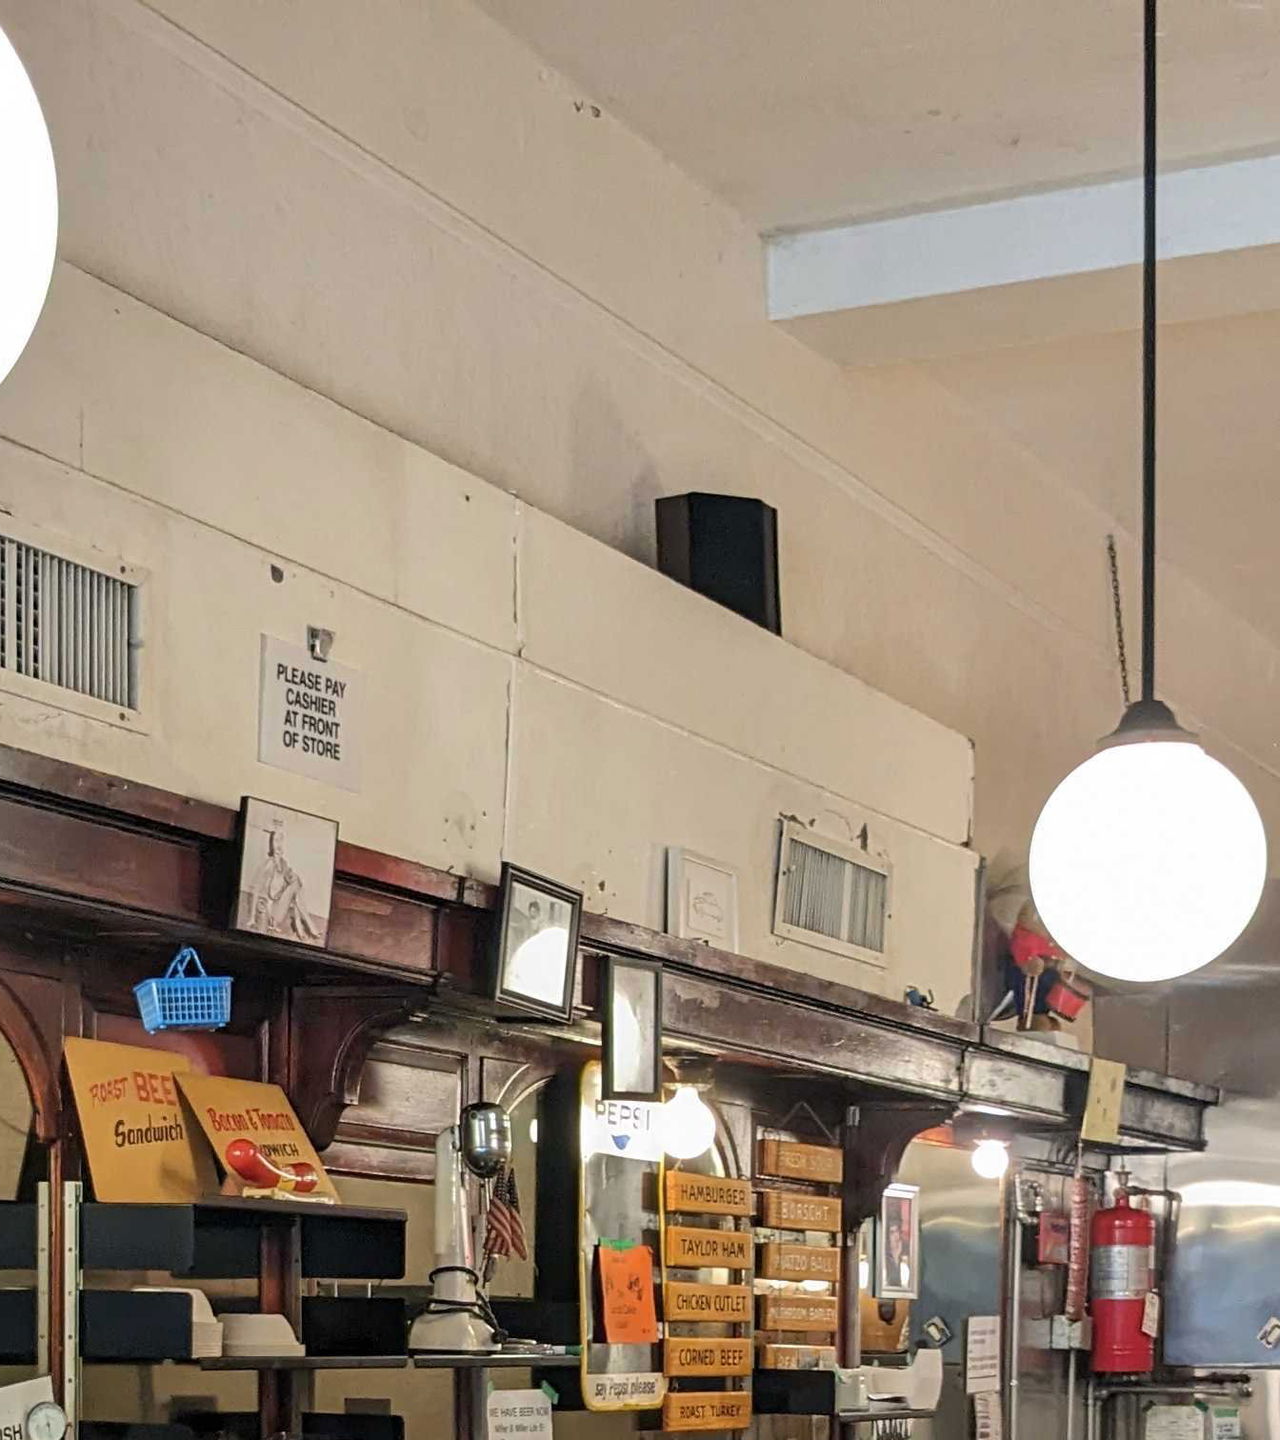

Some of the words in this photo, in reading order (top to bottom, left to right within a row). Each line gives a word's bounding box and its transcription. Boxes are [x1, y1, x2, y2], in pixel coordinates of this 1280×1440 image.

[277, 663, 322, 692] PLEASE
[325, 678, 346, 698] PAY
[286, 688, 336, 717] CASHIER
[283, 710, 298, 728] AT
[302, 714, 340, 739] FRONT
[283, 731, 299, 748] OF
[302, 735, 340, 760] STORE
[89, 1077, 128, 1109] ROAST
[133, 1071, 177, 1106] BEE
[207, 1107, 247, 1132] Bacon
[256, 1108, 295, 1132] Tomato
[595, 1099, 650, 1131] PEPSI
[114, 1113, 183, 1147] Sandwich
[680, 1184, 746, 1206] HAMBURGER
[781, 1202, 829, 1220] BORSCHT
[680, 1238, 719, 1257] TAYLOR
[722, 1241, 745, 1259] HAM
[810, 1256, 833, 1272] BALL
[676, 1294, 712, 1311] CHICKEN
[713, 1295, 746, 1313] CUTLET
[679, 1348, 715, 1366] CORNED
[720, 1349, 743, 1366] BEEF
[500, 1407, 517, 1417] HAVE
[680, 1405, 705, 1419] ROAST
[711, 1404, 741, 1417] TURKEY
